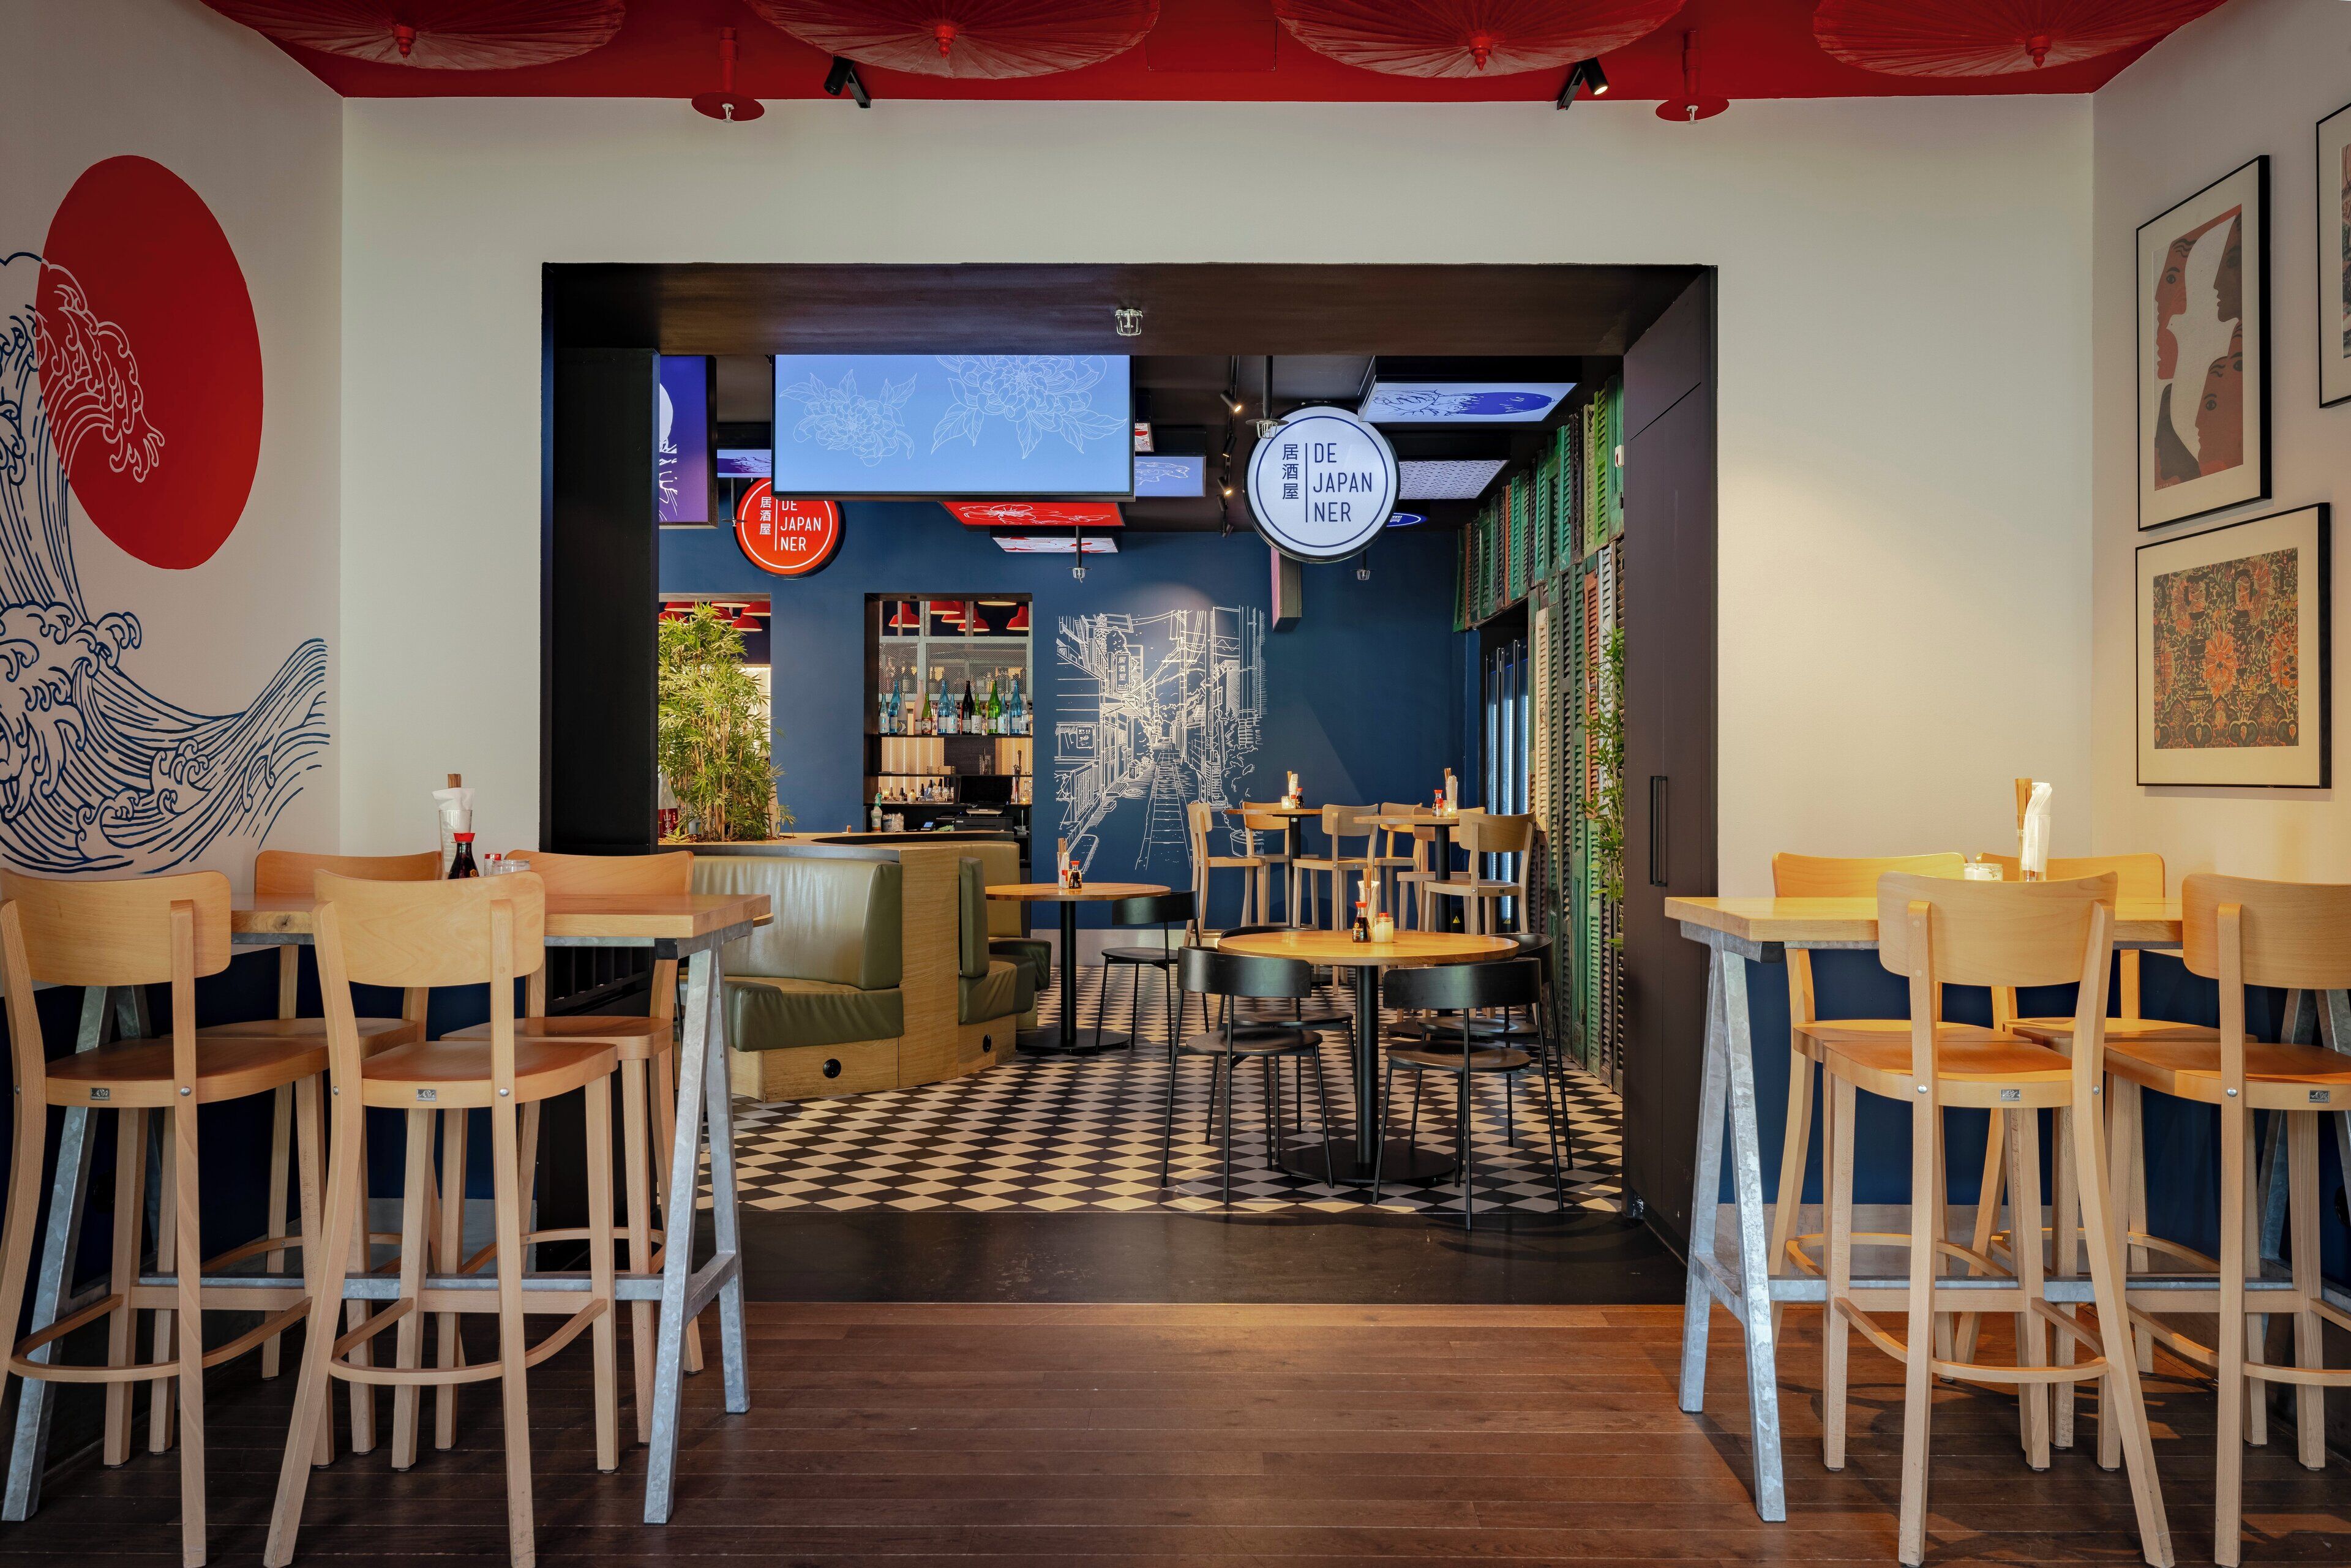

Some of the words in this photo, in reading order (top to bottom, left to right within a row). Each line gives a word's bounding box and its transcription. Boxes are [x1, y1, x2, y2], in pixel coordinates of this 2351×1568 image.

[1314, 443, 1337, 463] DE
[1282, 444, 1299, 500] 居酒屋
[1313, 472, 1372, 493] JAPAN
[782, 500, 798, 511] DE
[1314, 502, 1352, 522] NER
[759, 497, 772, 535] 居酒屋
[780, 517, 822, 531] JAPAN
[781, 536, 806, 551] NER
